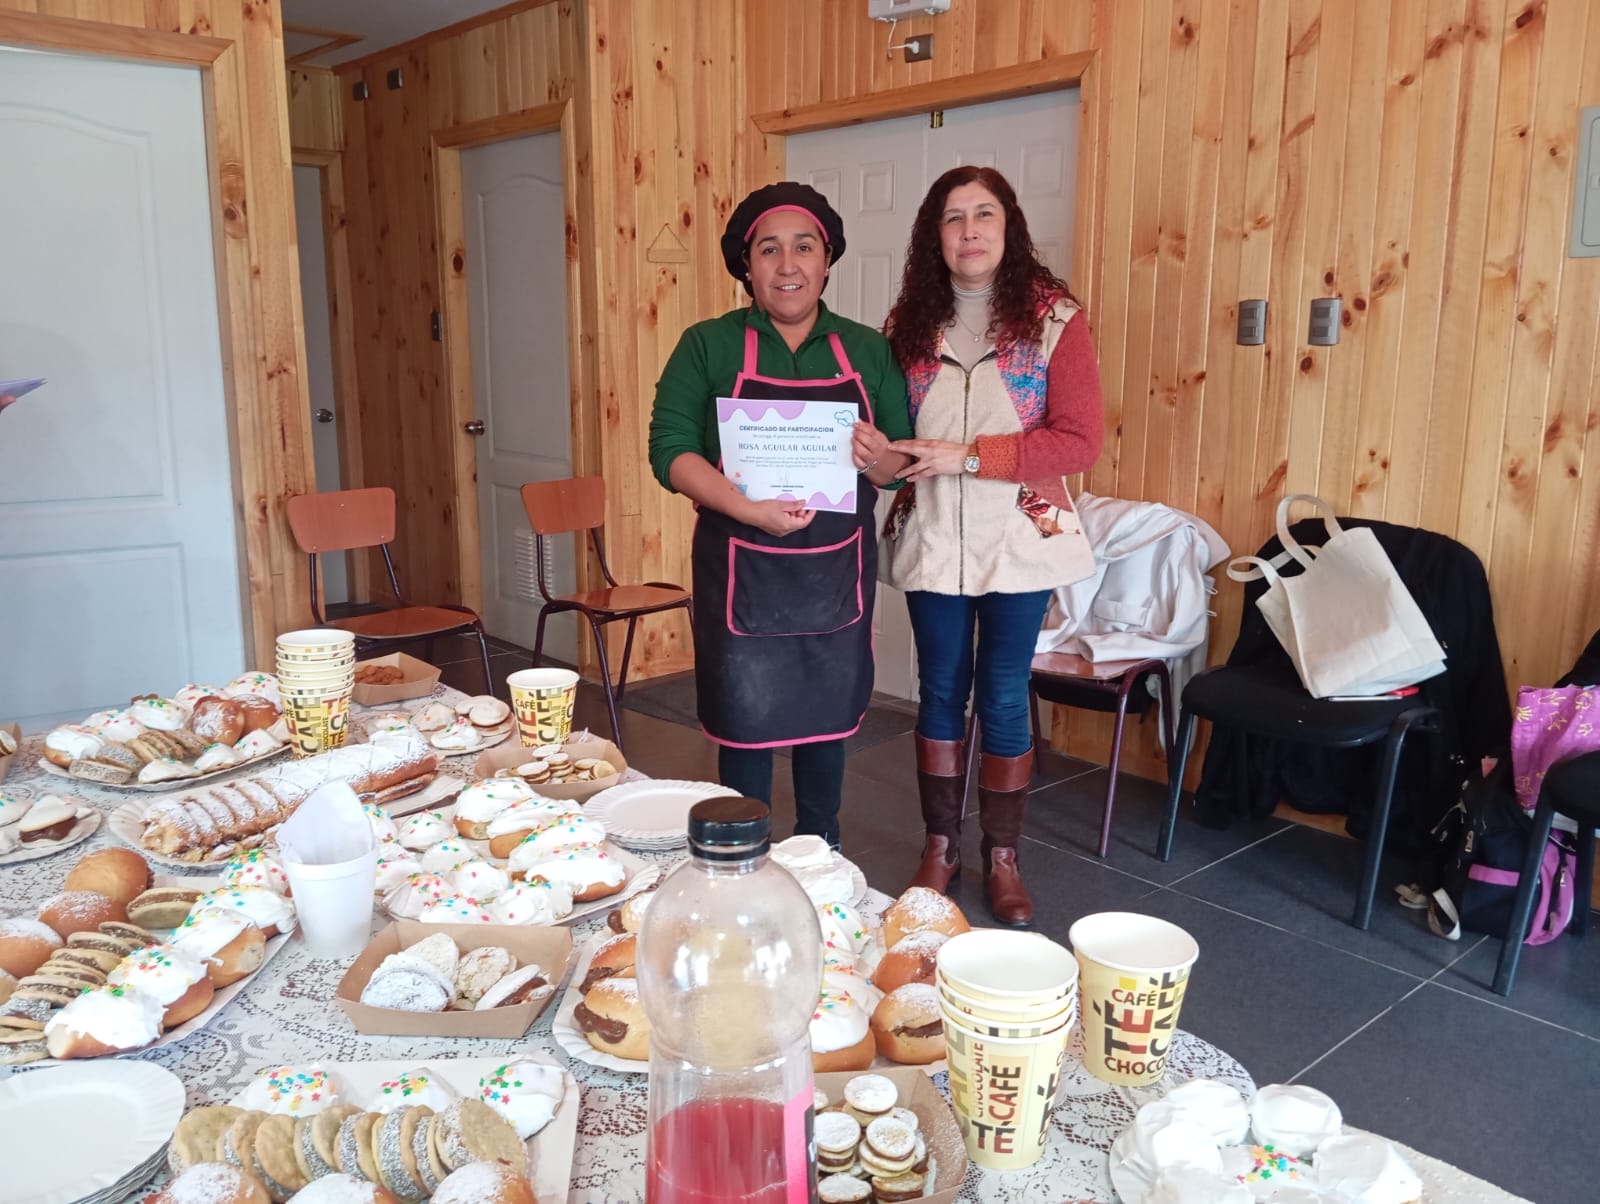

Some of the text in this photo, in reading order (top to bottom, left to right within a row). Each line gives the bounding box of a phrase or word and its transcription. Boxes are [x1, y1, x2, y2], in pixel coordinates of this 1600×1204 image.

[738, 442, 837, 452] ROSA AGUILAR AGUILAR
[1112, 988, 1157, 1006] CAFÉ
[984, 1065, 1021, 1121] CAFÉ
